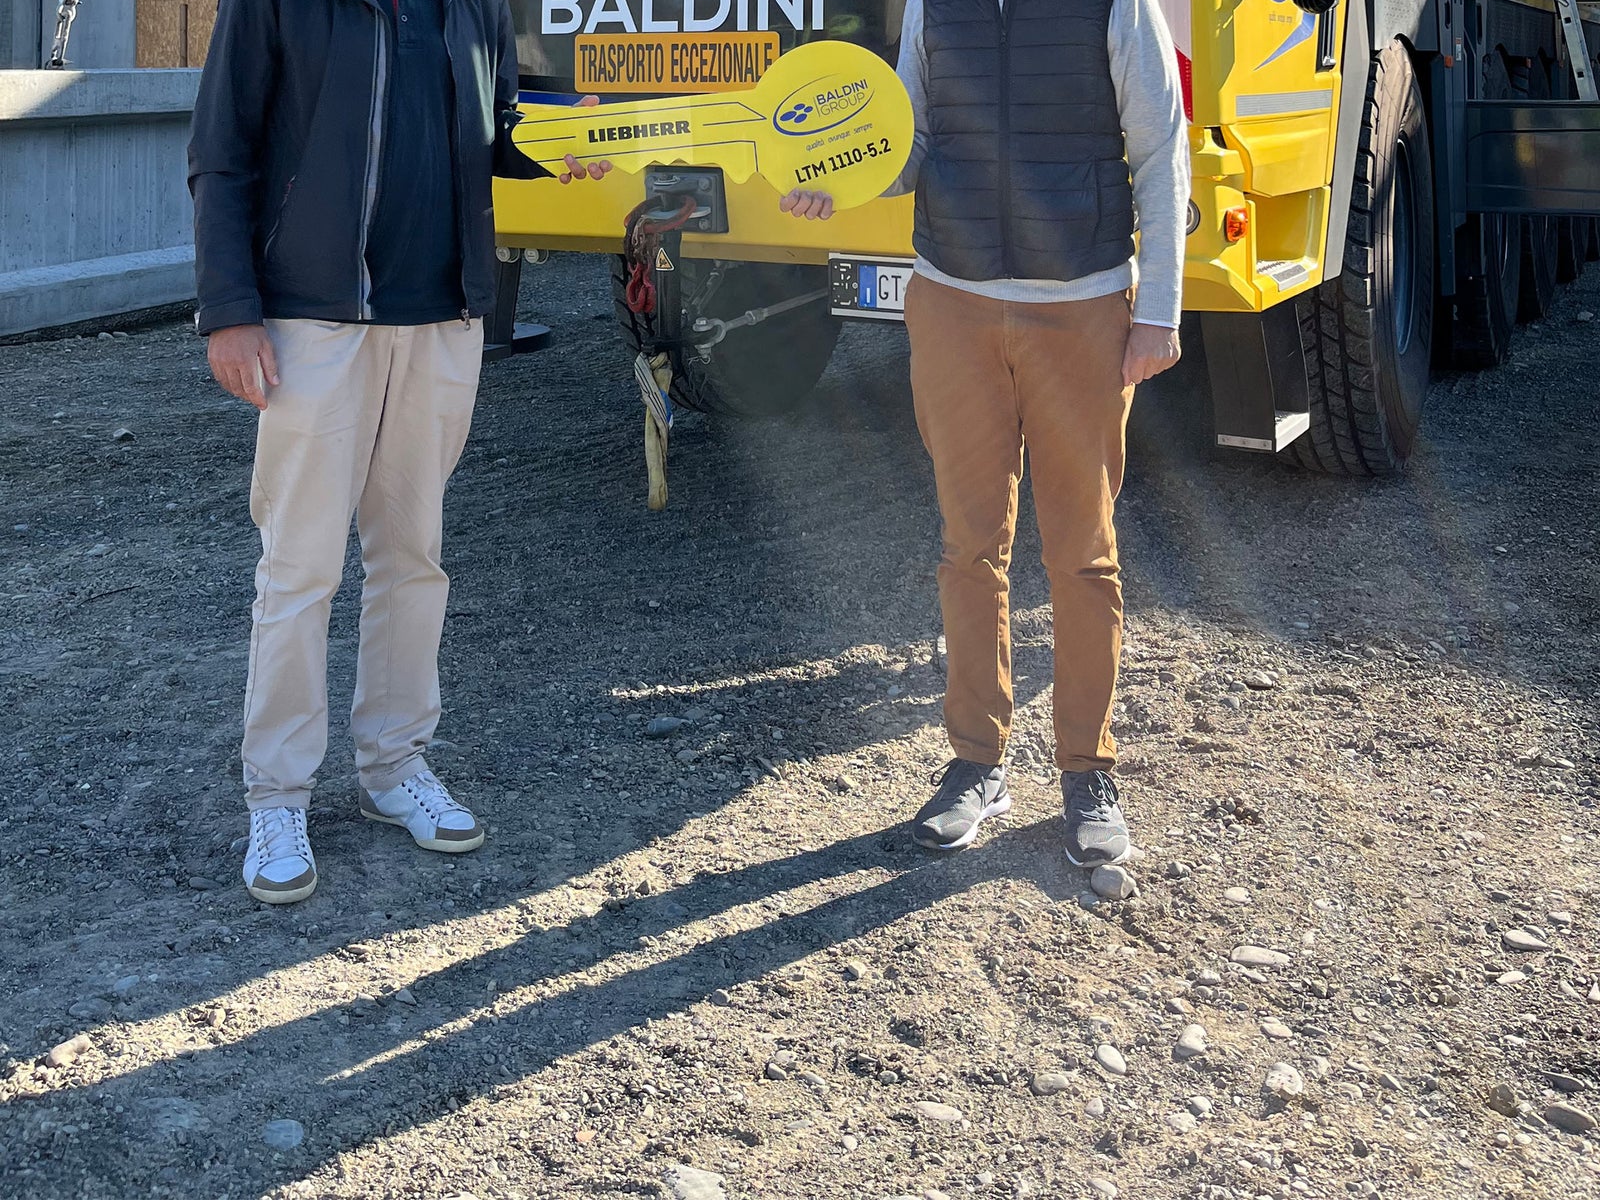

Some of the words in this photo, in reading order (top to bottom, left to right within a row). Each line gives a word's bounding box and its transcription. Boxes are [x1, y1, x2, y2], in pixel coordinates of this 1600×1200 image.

[579, 43, 665, 84] TRASPORTO
[671, 42, 773, 83] ECCEZIONALE
[816, 79, 868, 105] BALDINI
[820, 91, 865, 116] GROUP
[588, 120, 691, 143] LIEBHERR
[795, 160, 827, 184] LTM
[828, 138, 891, 172] 1110-5.2
